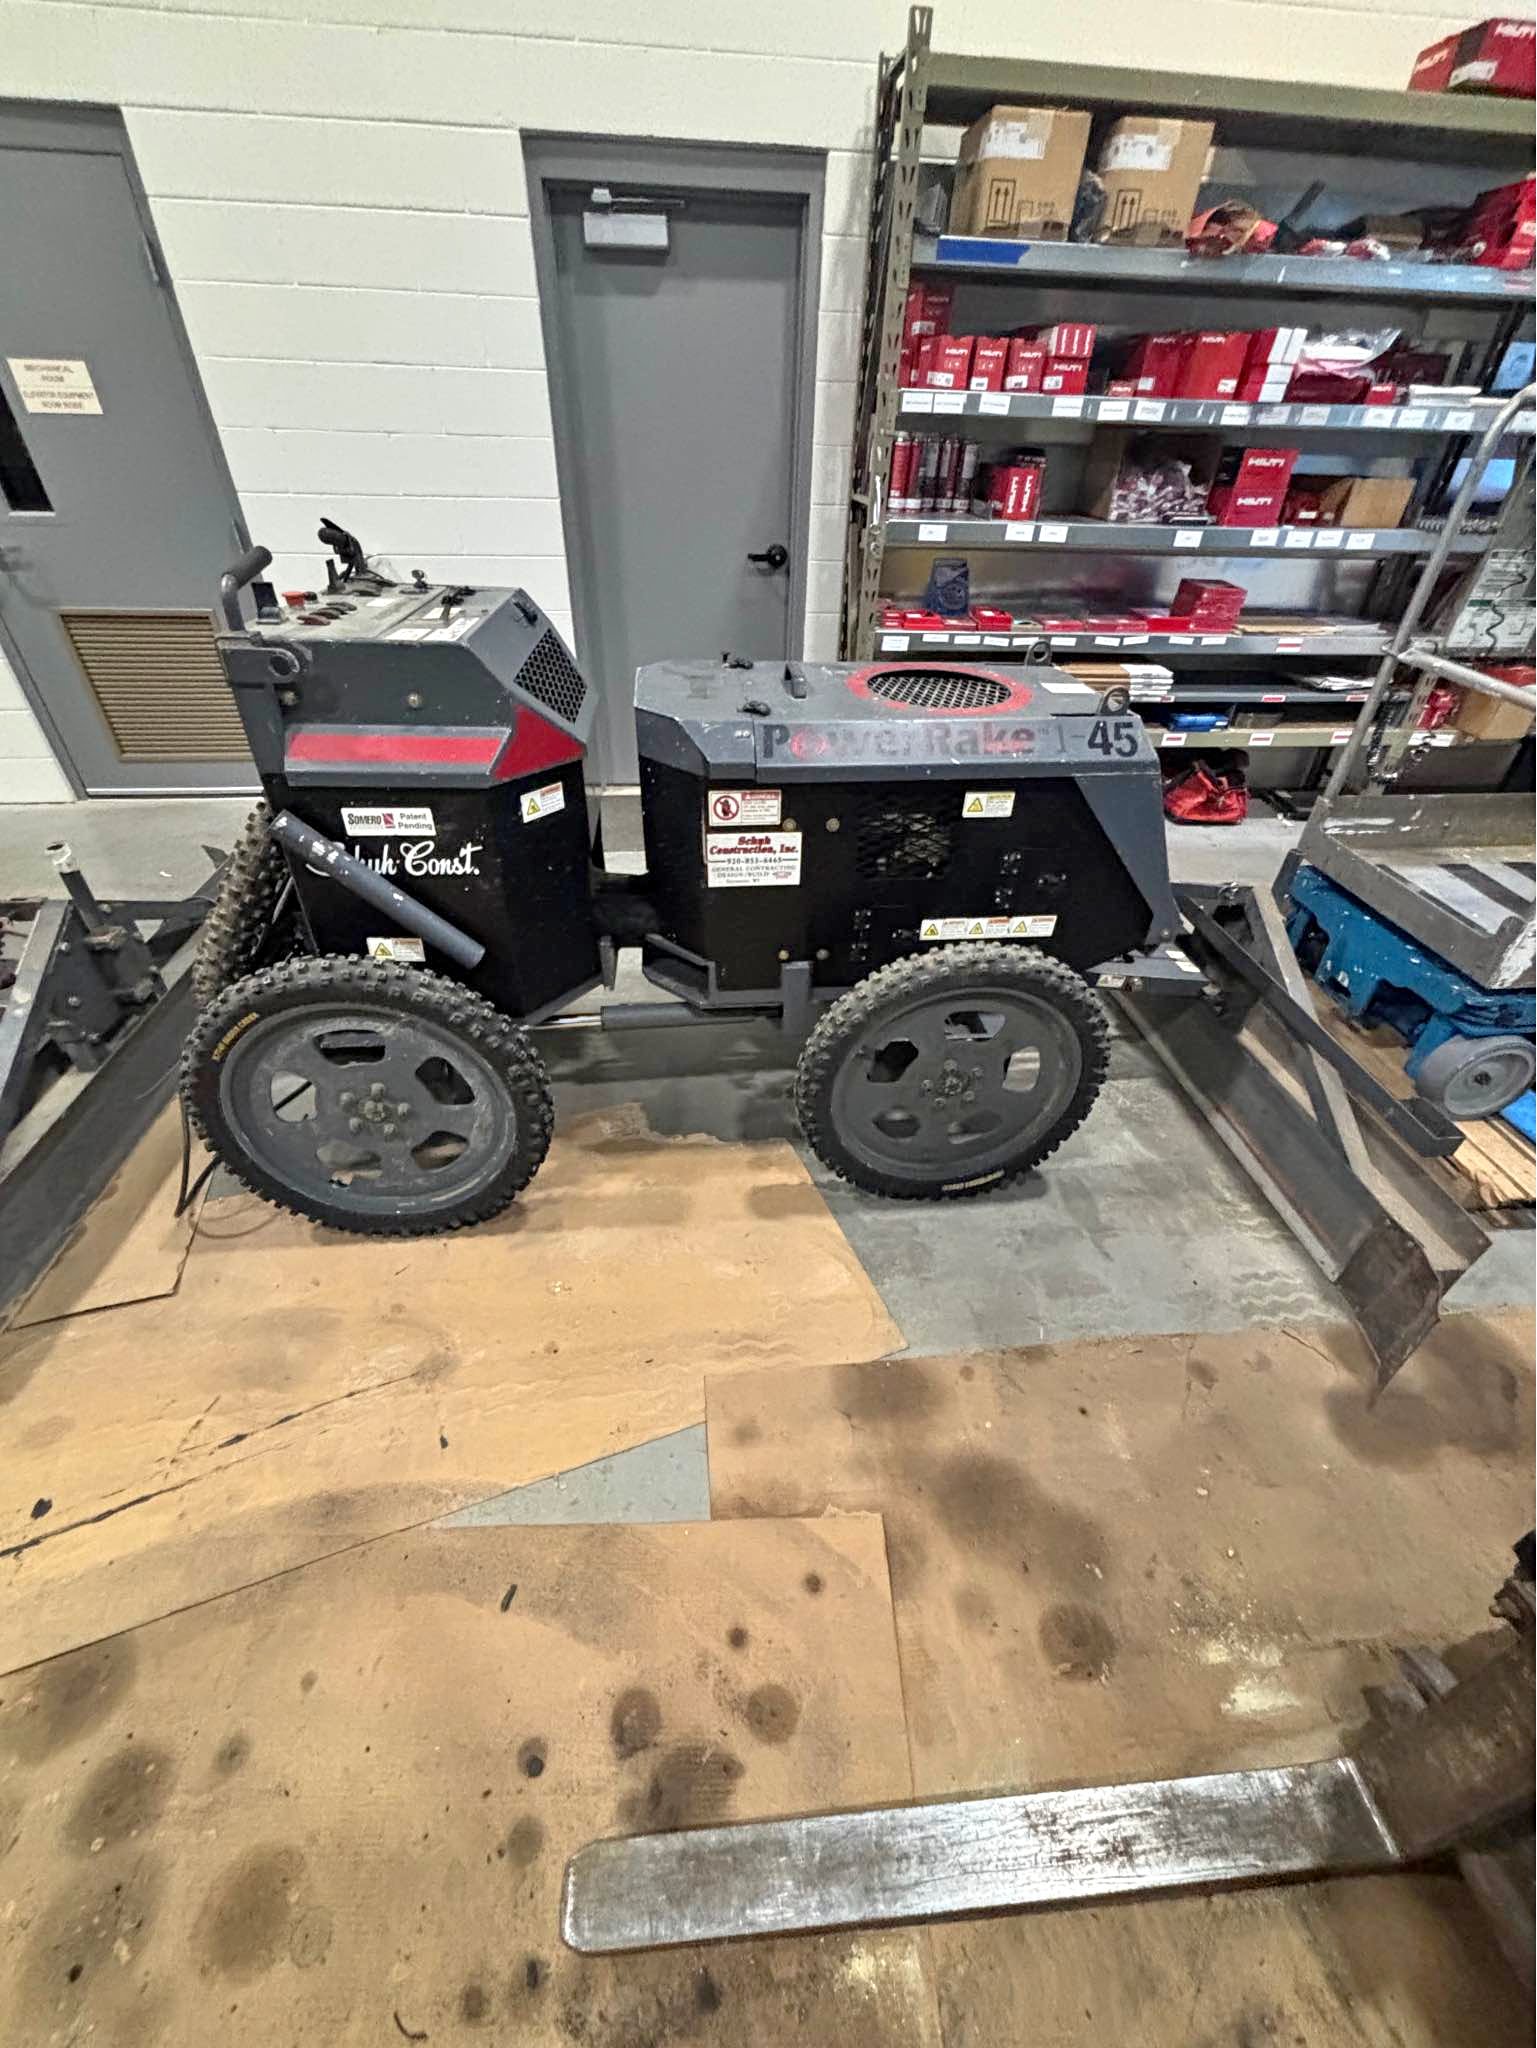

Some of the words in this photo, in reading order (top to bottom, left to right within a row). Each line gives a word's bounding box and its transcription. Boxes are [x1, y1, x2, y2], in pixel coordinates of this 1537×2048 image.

[945, 347, 969, 356] HILTI
[979, 349, 1003, 357] HILTI
[1053, 363, 1083, 371] HILTI
[1247, 457, 1286, 468] HILTI
[1007, 476, 1019, 514] HILTI
[1021, 475, 1034, 513] HILTI
[1236, 496, 1273, 506] HILTI
[399, 812, 426, 820] Patent
[398, 822, 433, 831] Pending
[737, 836, 772, 846] Schuh
[709, 845, 777, 855] Construction,
[779, 844, 799, 853] Inc.
[400, 840, 483, 876] Const.
